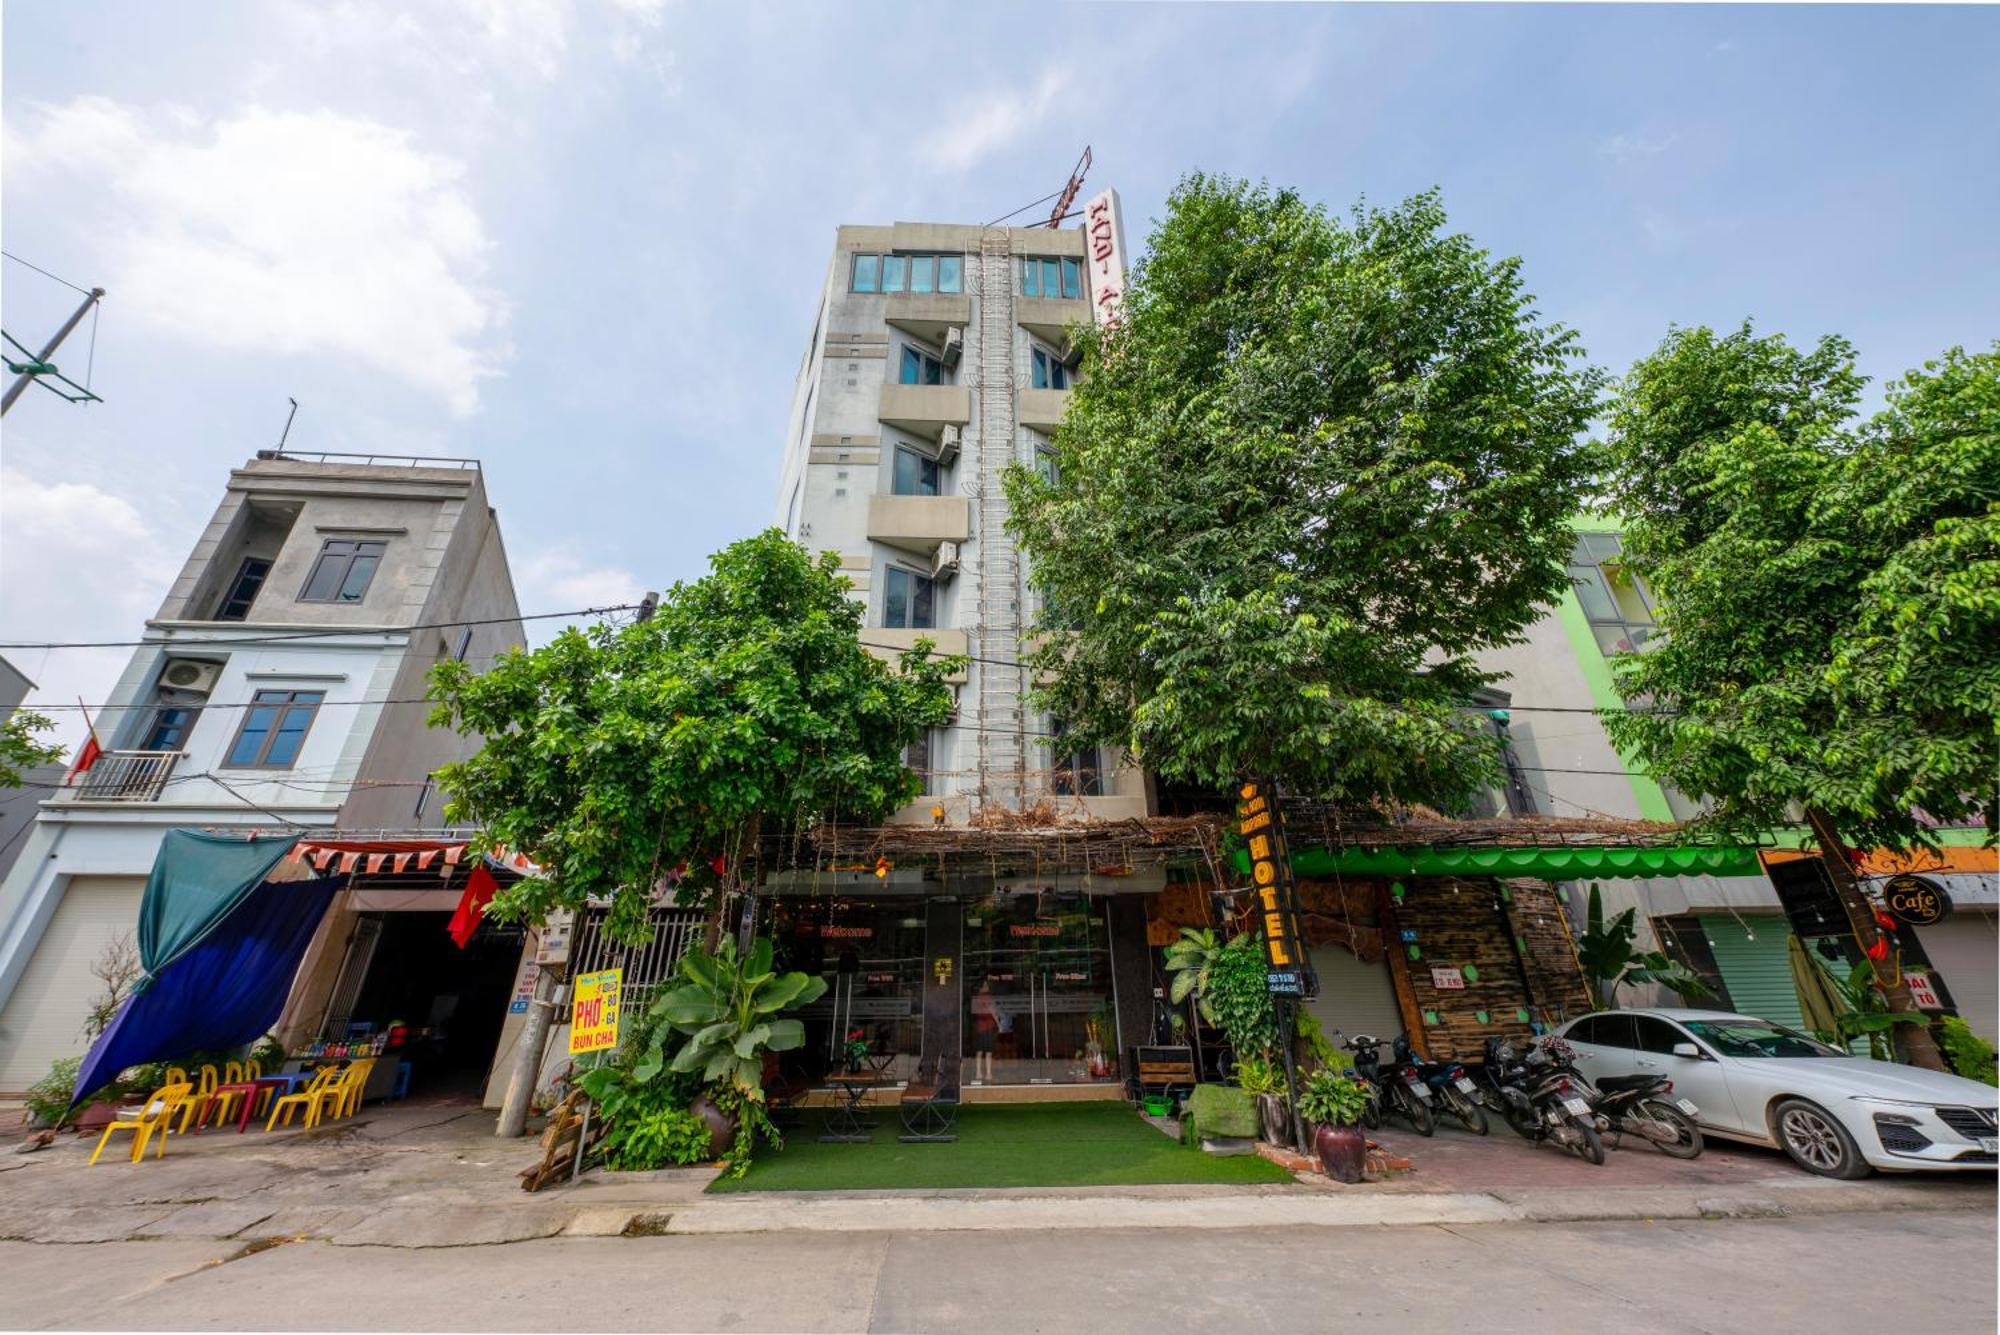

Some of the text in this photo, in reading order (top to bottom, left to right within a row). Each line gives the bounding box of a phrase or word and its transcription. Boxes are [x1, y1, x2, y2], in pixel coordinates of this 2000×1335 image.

[1249, 834, 1289, 965] HOTEL
[1892, 890, 1935, 912] Cafe
[821, 926, 873, 937] Welcome
